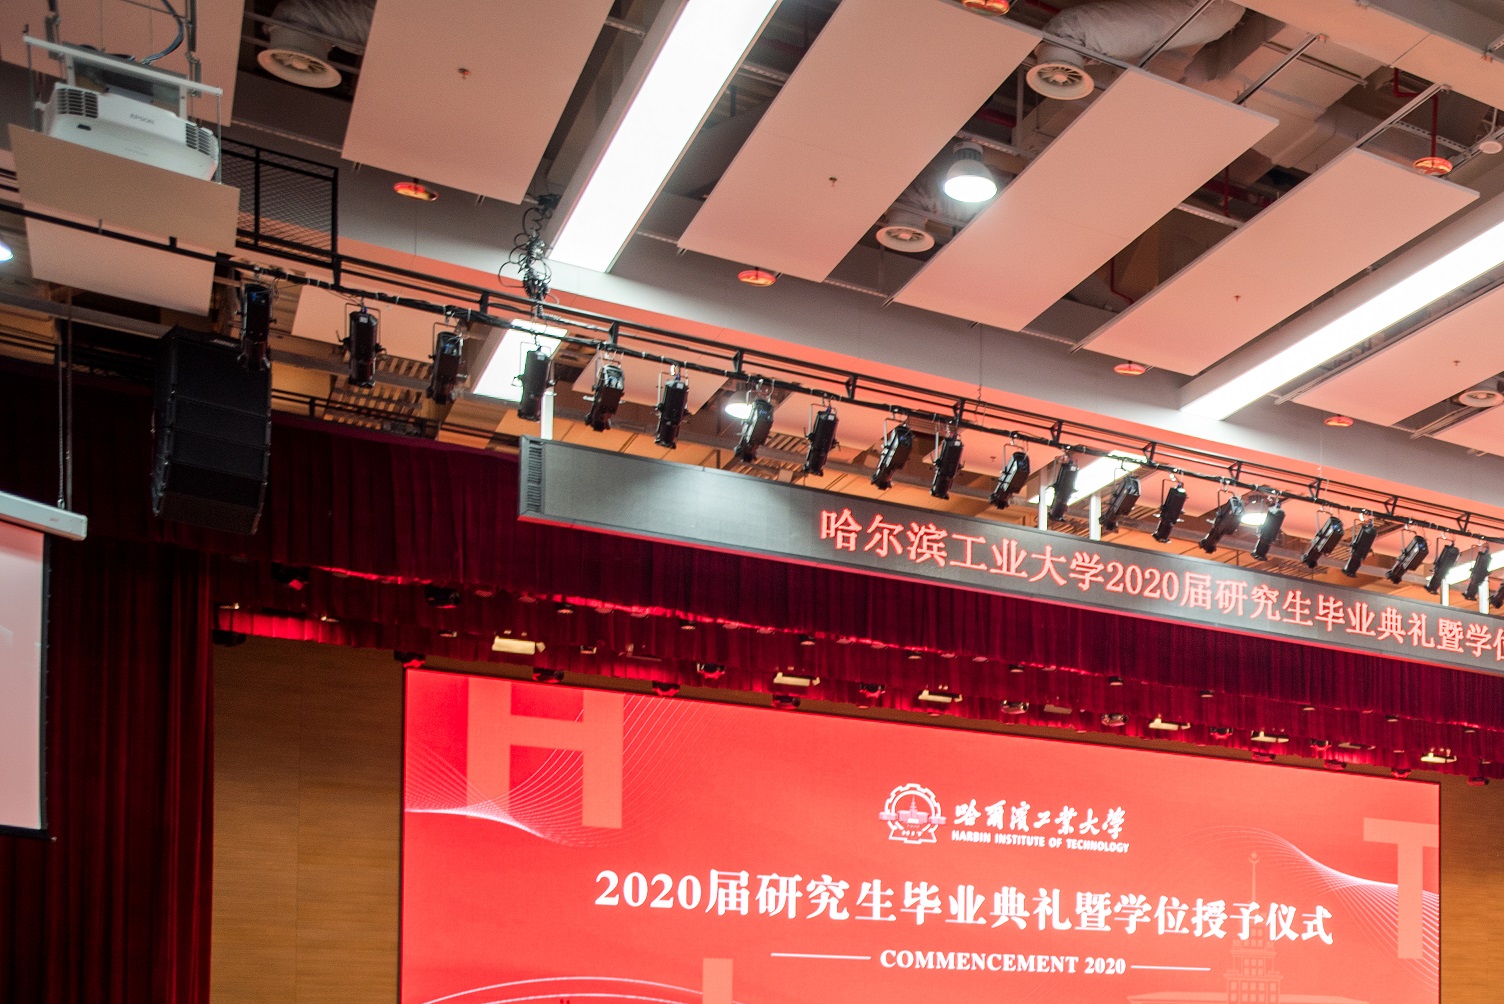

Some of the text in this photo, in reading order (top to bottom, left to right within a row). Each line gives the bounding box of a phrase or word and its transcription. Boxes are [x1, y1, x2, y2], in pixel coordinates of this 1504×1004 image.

[951, 829, 1130, 854] HARBIN INSTITUTE OF TECHNOLOGY
[594, 868, 1334, 945] 2020届研究生毕业典礼暨学位授予仪式
[880, 949, 1127, 975] COMMENCEMENT 2020
